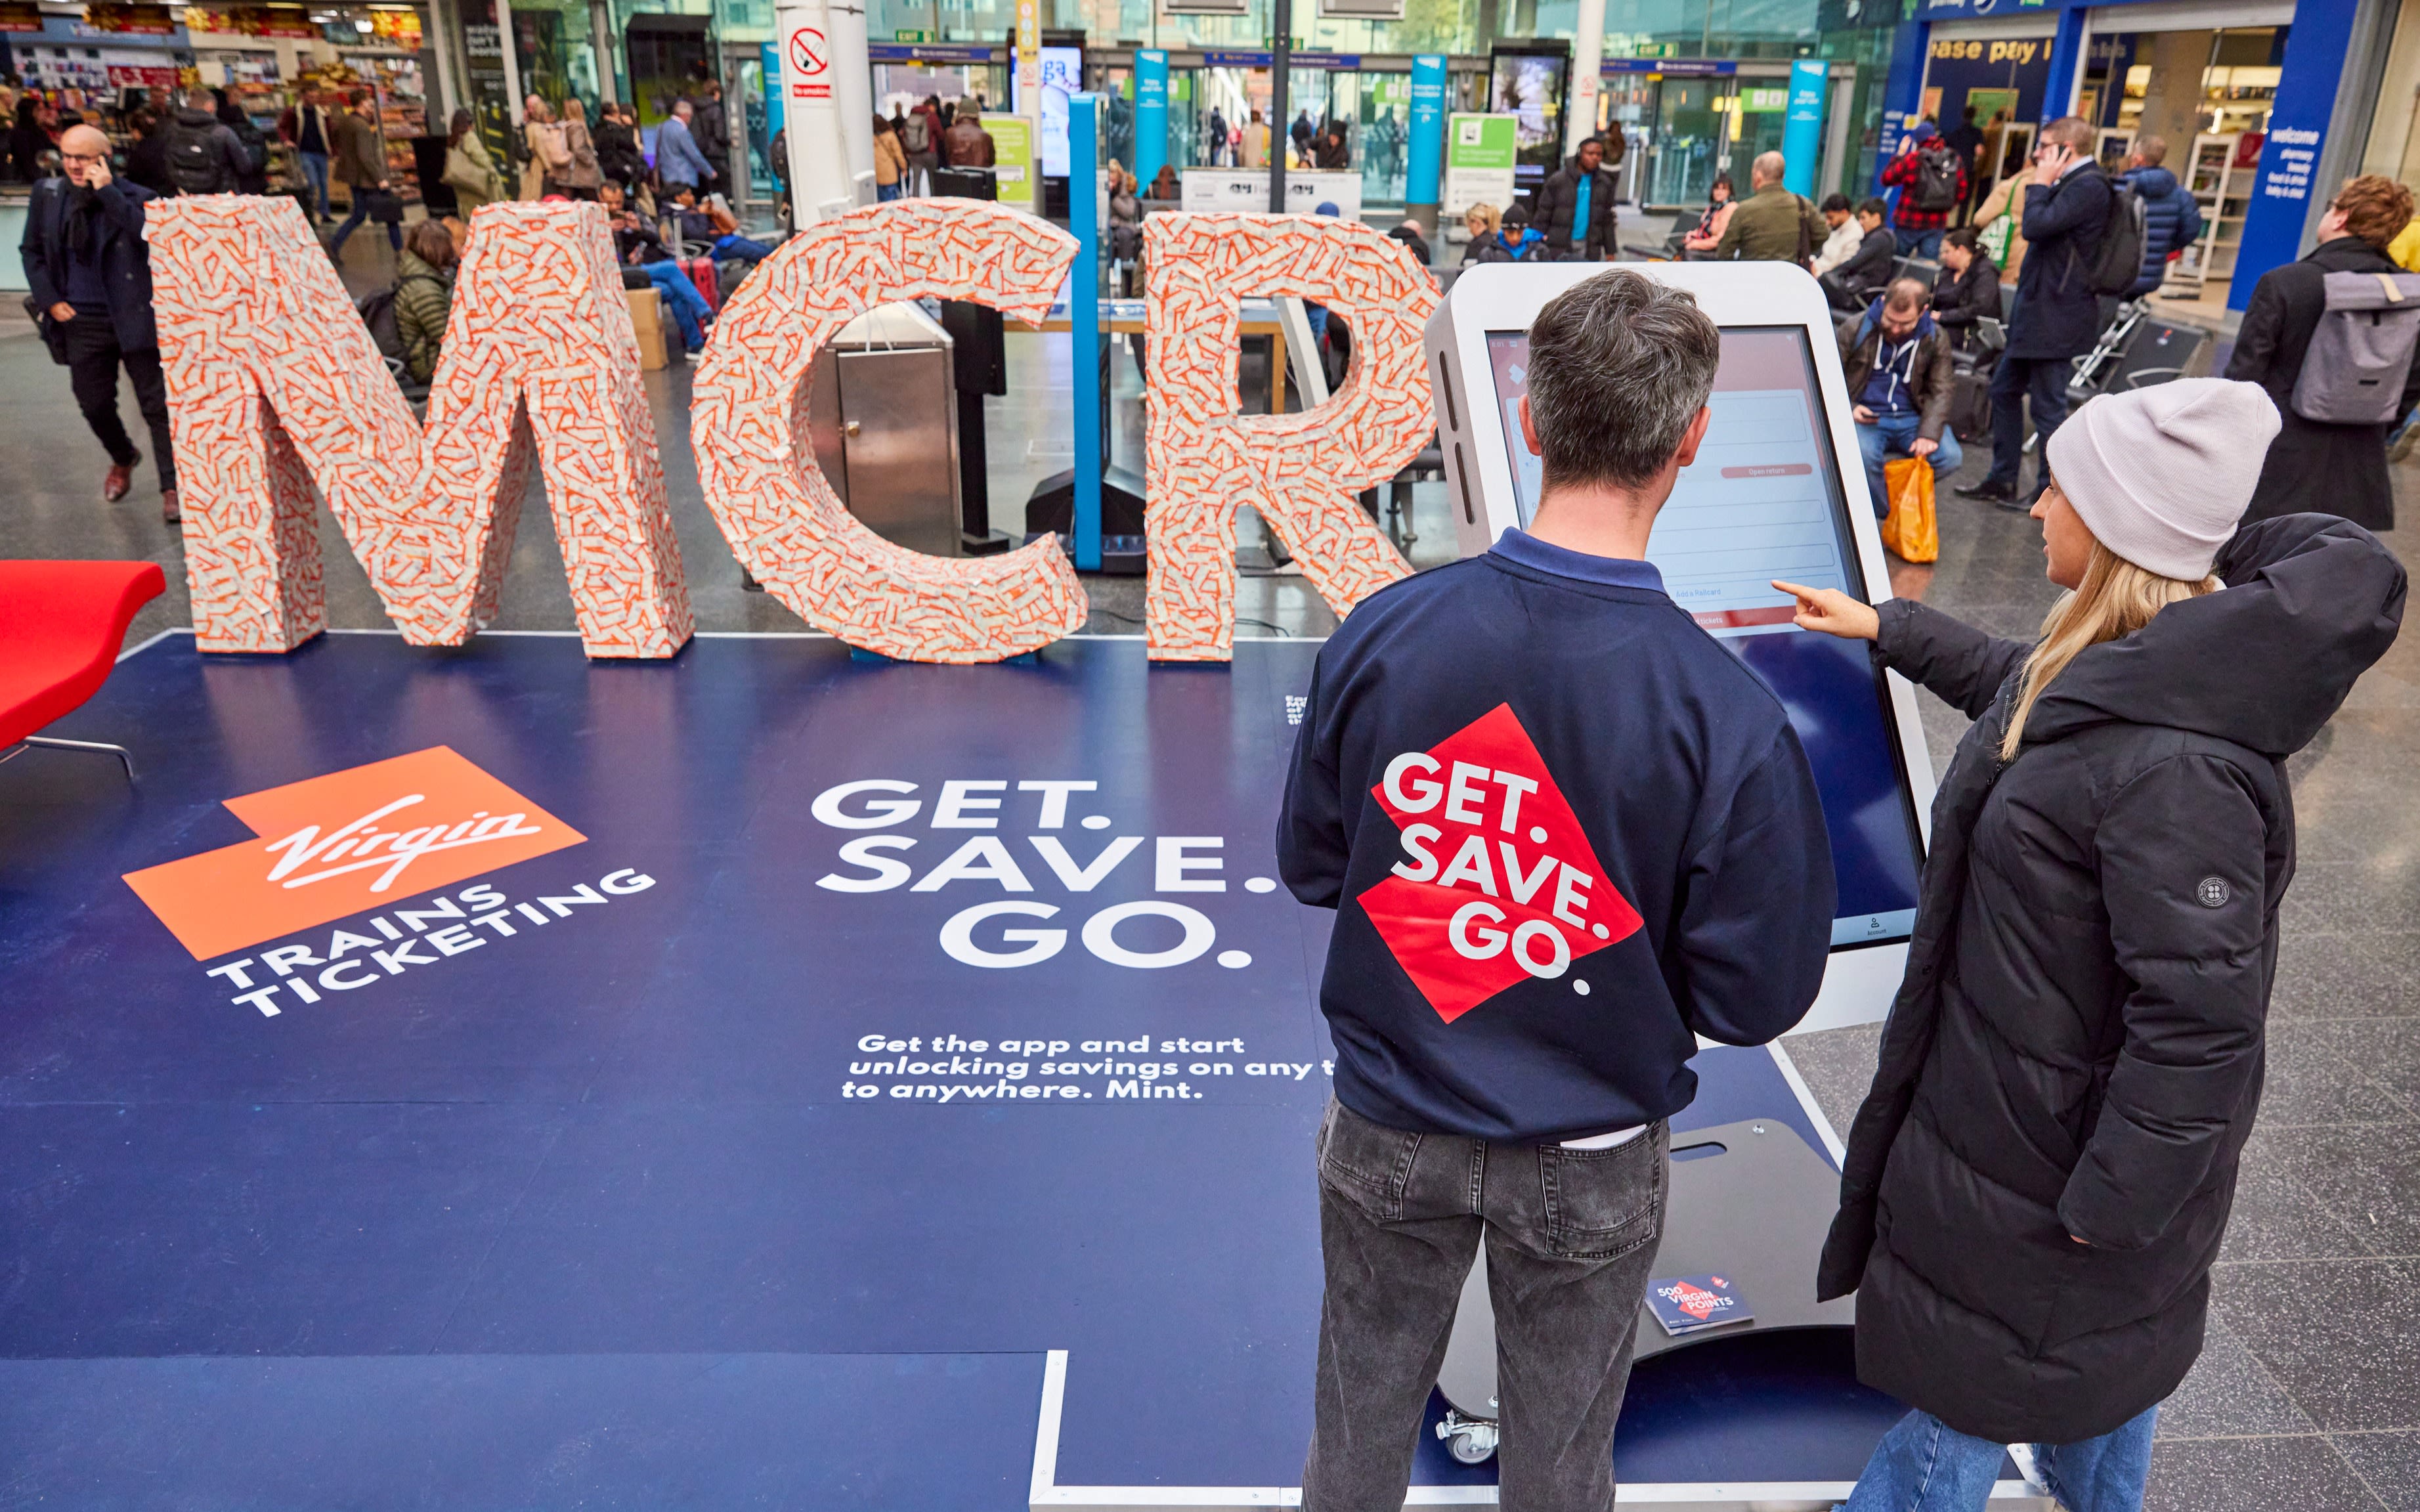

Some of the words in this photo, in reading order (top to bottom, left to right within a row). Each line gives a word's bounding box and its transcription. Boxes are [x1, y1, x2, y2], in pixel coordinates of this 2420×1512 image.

[1989, 41, 2037, 64] pay
[142, 192, 1444, 664] MCR
[1749, 468, 1765, 477] Open
[1700, 616, 1723, 625] tickets
[811, 779, 1111, 830] GET.
[1383, 752, 1548, 844] GET.
[265, 794, 541, 892] Virgin
[815, 835, 1277, 893] SAVE.
[1390, 823, 1610, 940] SAVE.
[206, 883, 507, 989] TRAINS
[231, 868, 657, 1018] TICKETING
[939, 900, 1253, 969] GO.
[1448, 901, 1590, 995] GO.
[849, 1056, 1029, 1079] unlocking
[1039, 1058, 1178, 1079] savings
[1188, 1063, 1234, 1075] on
[1244, 1063, 1313, 1081] any
[857, 1035, 922, 1052] Get
[932, 1035, 989, 1052] the
[999, 1041, 1070, 1056] app
[1080, 1035, 1150, 1053] and
[1160, 1037, 1245, 1053] start
[842, 1081, 880, 1098] to
[890, 1079, 1092, 1103] anywhere.
[1106, 1080, 1203, 1098] Mint.
[1657, 1286, 1683, 1297] 500
[1668, 1290, 1715, 1304] VIRGIN
[1687, 1296, 1734, 1310] POINTS
